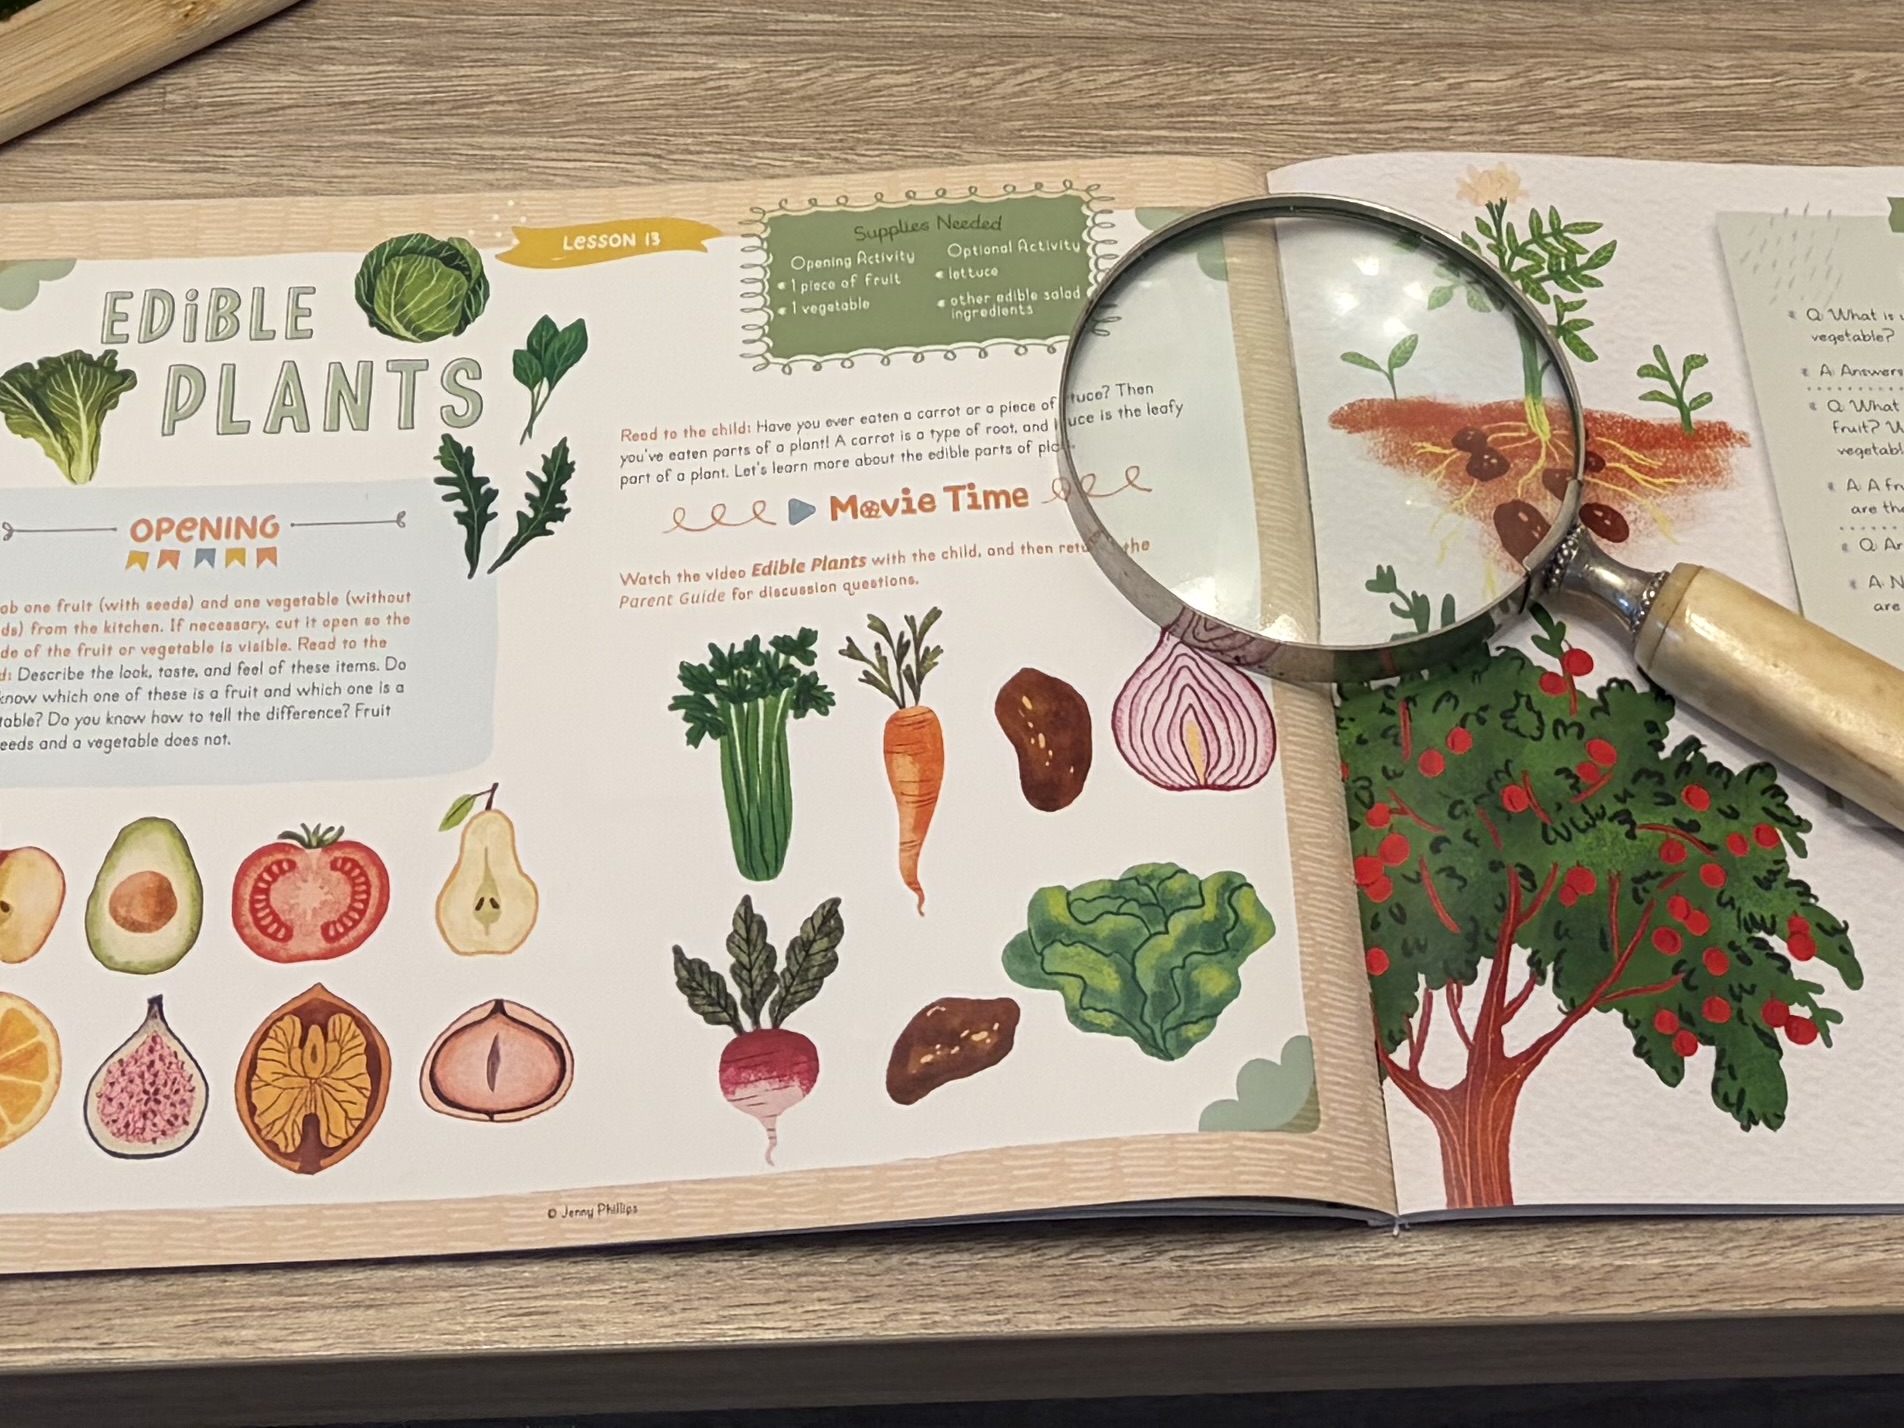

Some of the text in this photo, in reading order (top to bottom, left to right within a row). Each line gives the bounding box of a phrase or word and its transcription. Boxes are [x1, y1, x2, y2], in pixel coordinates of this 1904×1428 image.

[644, 230, 661, 248] 13
[854, 214, 1002, 244] Supplies Needed
[948, 239, 1080, 259] Optional Activity
[791, 251, 914, 271] Opening Activity
[792, 273, 900, 294] 1 piece of fruit
[949, 267, 998, 280] lettuce
[792, 297, 869, 316] 1 vegetable
[951, 286, 1080, 306] other edible salad
[952, 305, 1033, 322] ingredients
[161, 356, 484, 437] PLANTS
[621, 382, 1154, 441] Read to the child: Have you ever eaten a carrot or a piece of Then
[1833, 419, 1880, 434] fruit?
[830, 482, 1029, 521] Movie Time
[620, 570, 670, 586] Watch
[677, 569, 700, 583] the
[706, 566, 746, 580] video
[752, 558, 805, 577] Edible
[811, 555, 866, 572] Plants
[872, 550, 905, 565] with
[912, 549, 935, 562] the
[942, 544, 981, 560] child,
[987, 542, 1014, 556] and
[1021, 541, 1053, 554] then
[24, 604, 51, 613] one
[57, 599, 92, 612] fruit
[99, 597, 139, 612] (with
[146, 595, 193, 611] seeds)
[201, 595, 228, 609] and
[234, 599, 260, 608] one
[267, 592, 338, 612] vegetable
[346, 590, 411, 606] (without
[619, 576, 919, 608] Parent Guide for discussion questions.
[18, 666, 84, 681] Describe
[91, 665, 114, 679] the
[120, 664, 152, 679] look,
[159, 666, 198, 678] taste,
[204, 662, 231, 677] and
[238, 661, 263, 676] feel
[269, 660, 285, 675] of
[292, 660, 330, 674] these
[336, 660, 379, 672] items.
[385, 656, 406, 671] Do
[43, 689, 88, 703] which
[93, 692, 119, 702] one
[125, 686, 142, 701] of
[148, 686, 187, 701] these
[193, 688, 204, 700] is
[210, 690, 218, 699] a
[225, 684, 258, 699] fruit
[264, 683, 291, 698] and
[297, 682, 341, 696] which
[347, 685, 373, 695] one
[380, 681, 390, 694] is
[396, 684, 404, 693] a
[48, 711, 69, 726] Do
[74, 716, 100, 730] you
[106, 711, 146, 725] know
[151, 710, 183, 724] how
[190, 711, 203, 723] to
[210, 707, 231, 722] tell
[238, 707, 260, 721] the
[266, 703, 350, 720] difference?
[355, 703, 390, 718] Fruit
[39, 734, 67, 750] and
[73, 739, 81, 749] a
[88, 733, 158, 754] vegetable
[164, 732, 199, 747] does
[204, 734, 231, 745] not.
